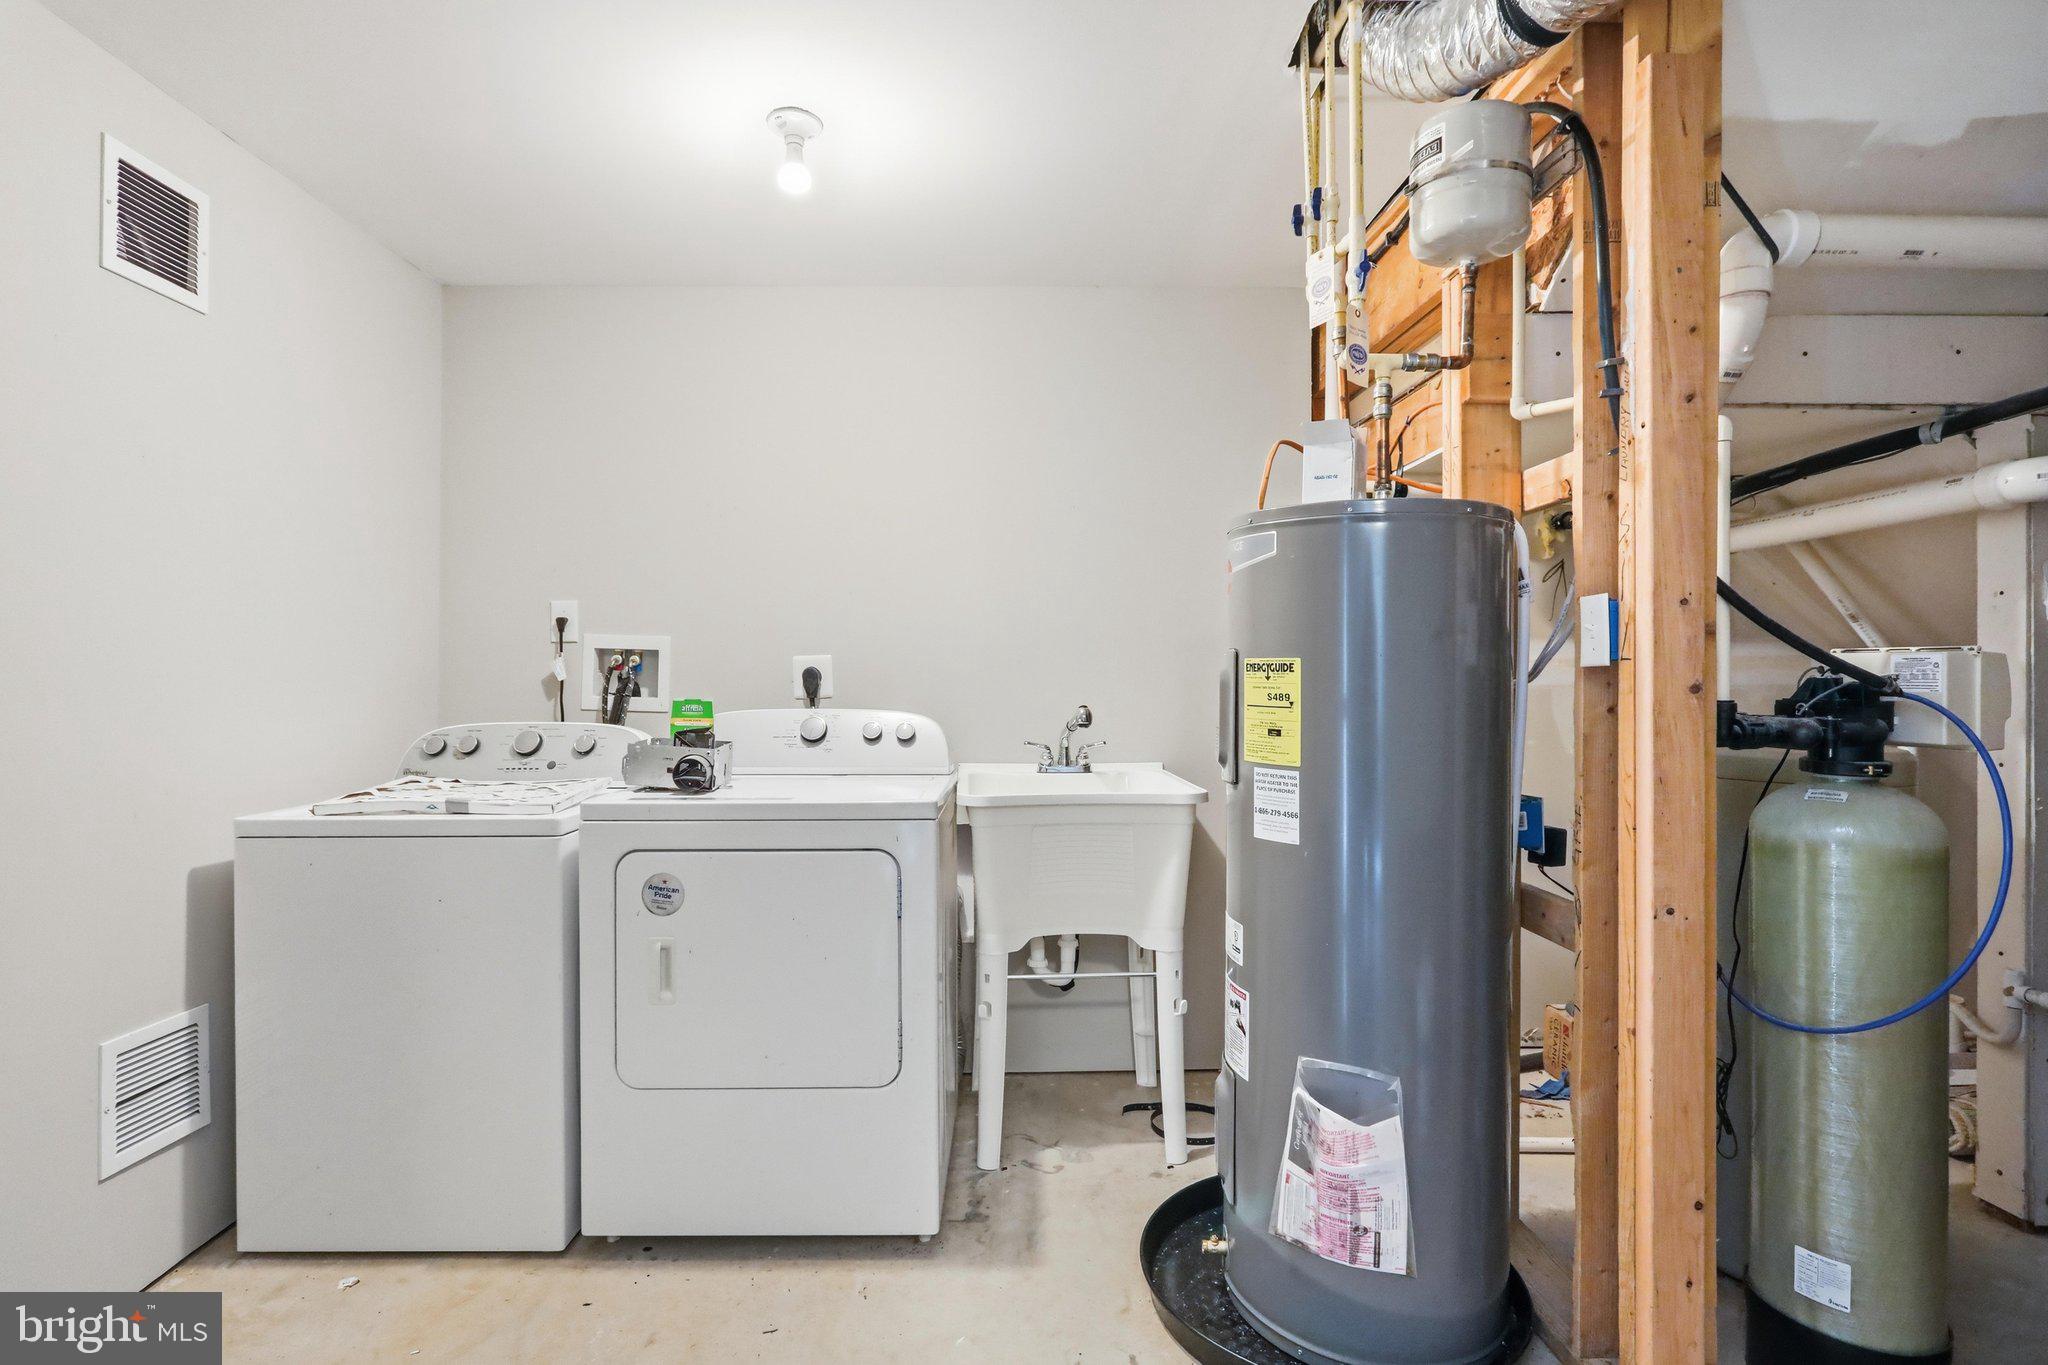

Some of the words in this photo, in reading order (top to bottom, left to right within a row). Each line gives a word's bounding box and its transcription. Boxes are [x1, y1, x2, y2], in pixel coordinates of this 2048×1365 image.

[1246, 663, 1295, 677] ENERGYGUIDE
[648, 884, 680, 893] American
[654, 891, 672, 899] Pride
